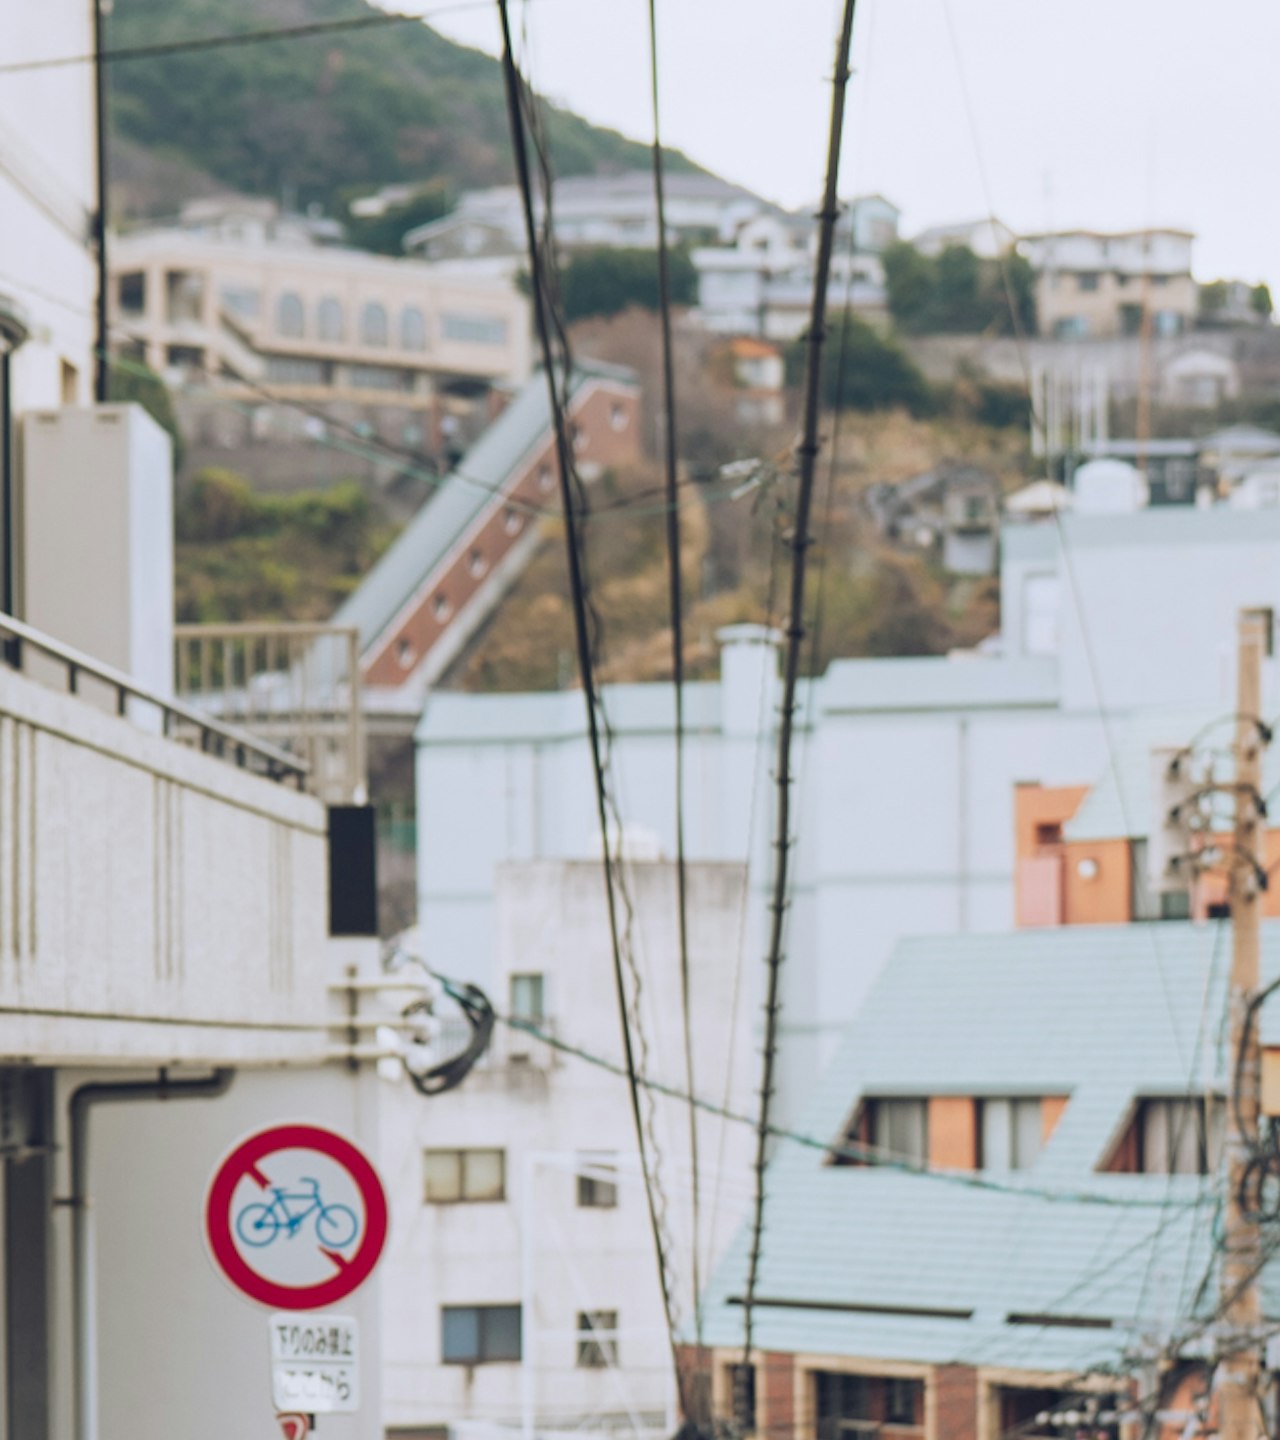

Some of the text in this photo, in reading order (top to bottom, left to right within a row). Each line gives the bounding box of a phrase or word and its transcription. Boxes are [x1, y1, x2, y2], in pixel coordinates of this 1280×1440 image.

[276, 1324, 353, 1355] 下りのみ禁止
